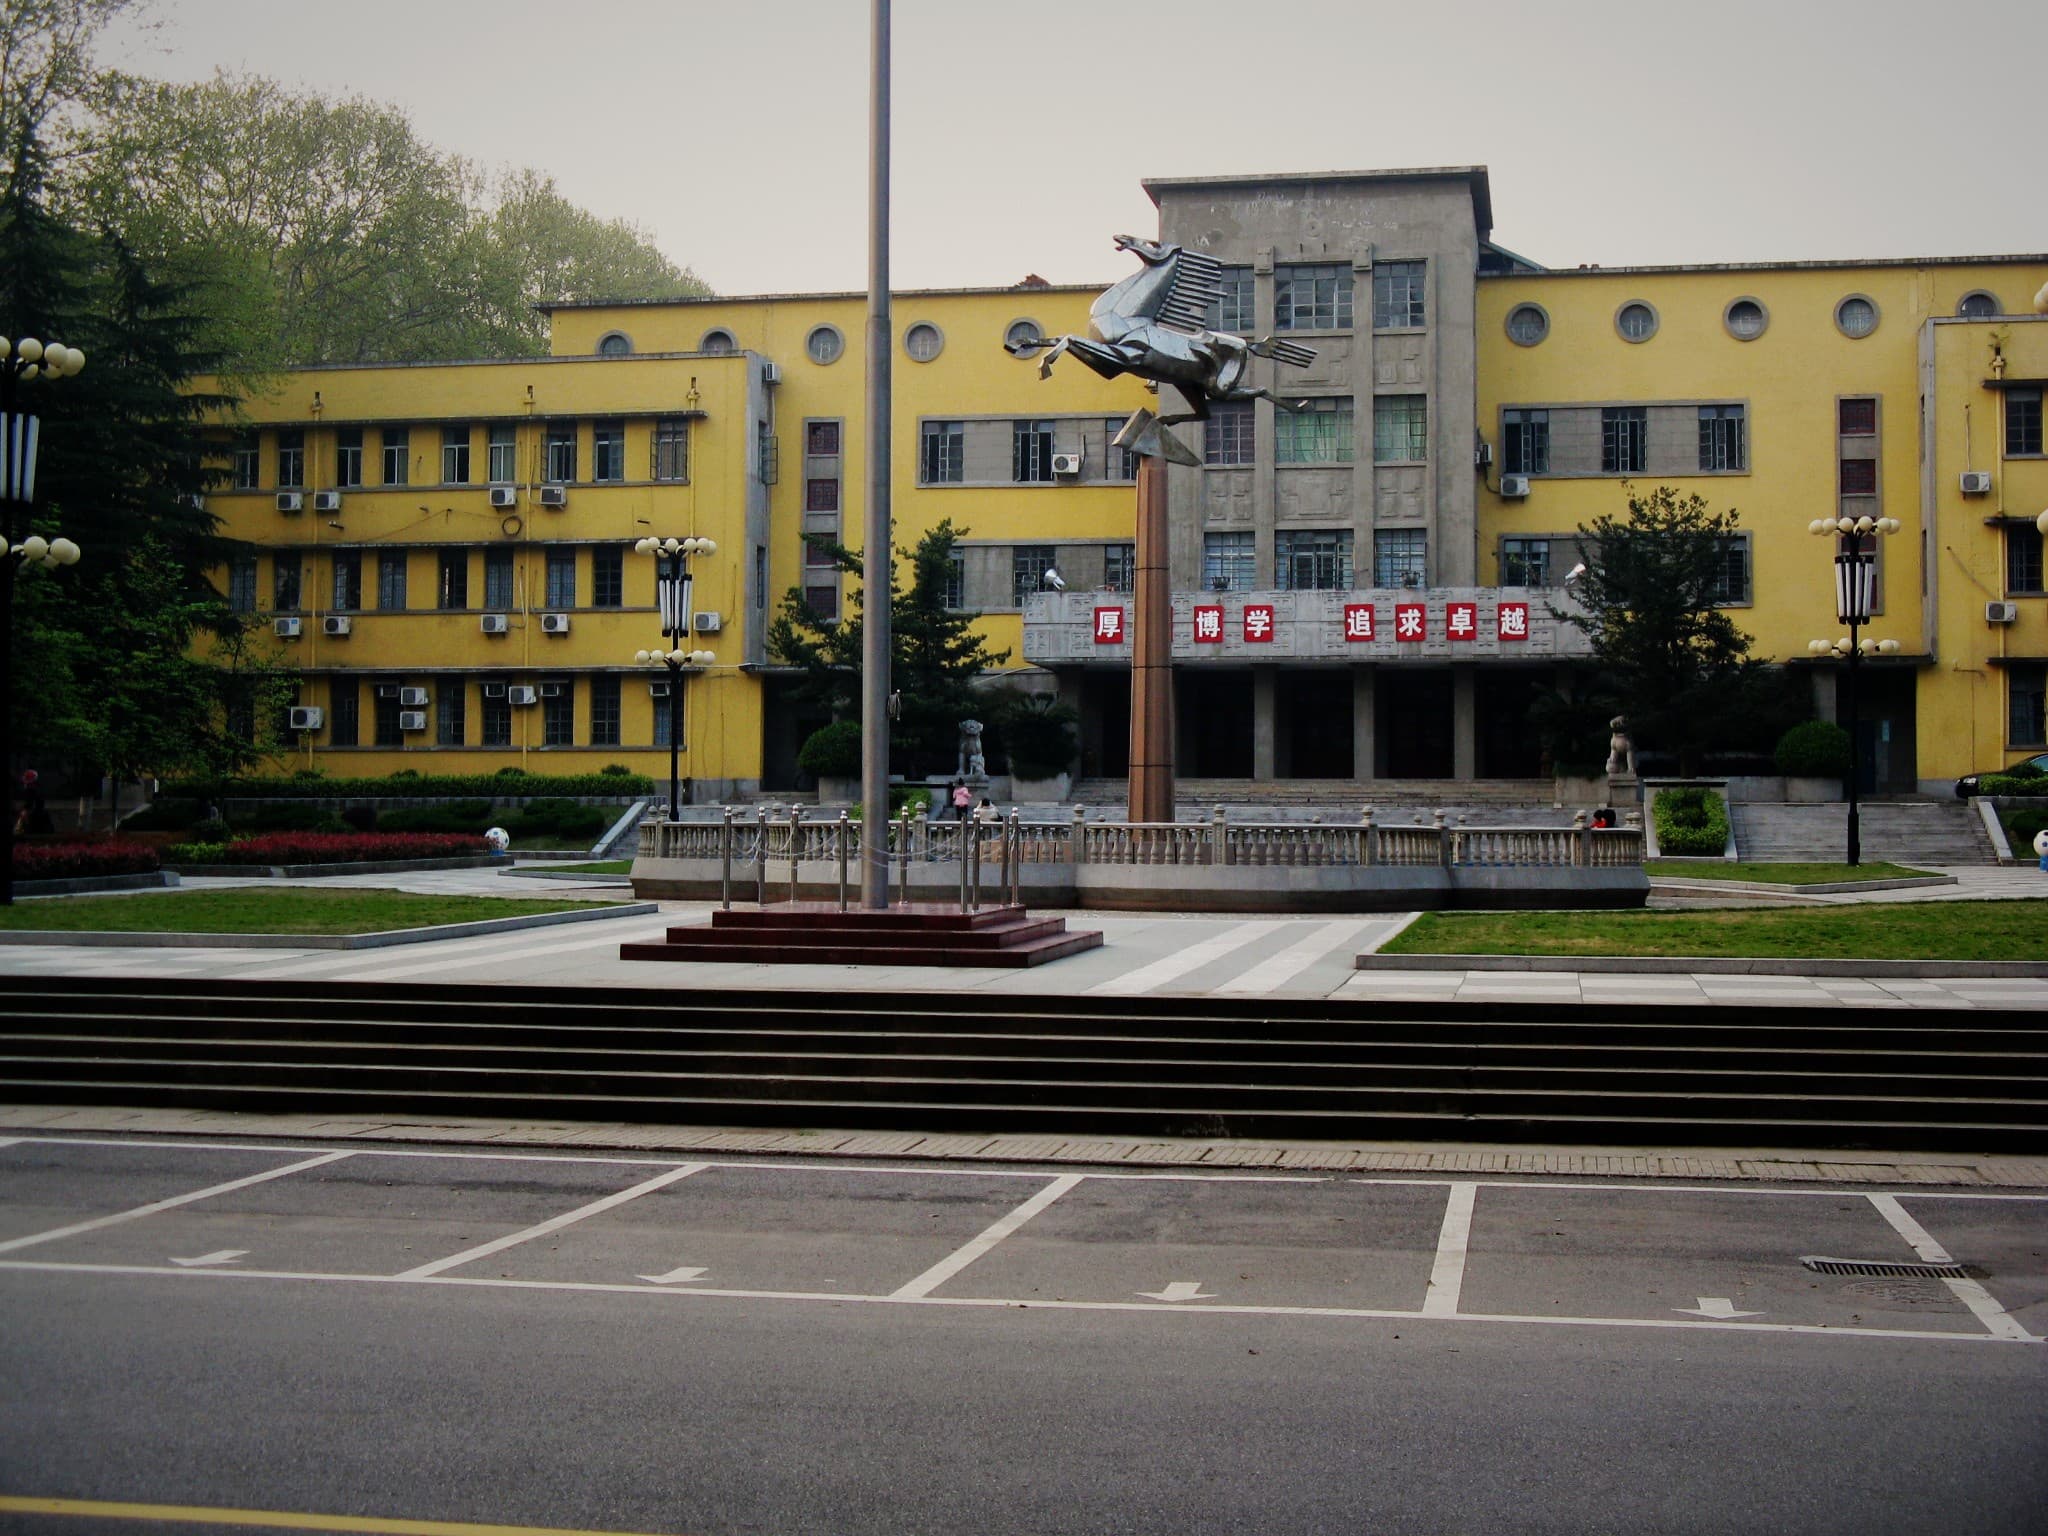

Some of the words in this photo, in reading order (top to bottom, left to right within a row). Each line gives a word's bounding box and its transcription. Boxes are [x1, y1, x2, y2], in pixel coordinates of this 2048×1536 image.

[1097, 610, 1270, 638] 厚博学
[1347, 607, 1526, 636] 追求卓越
